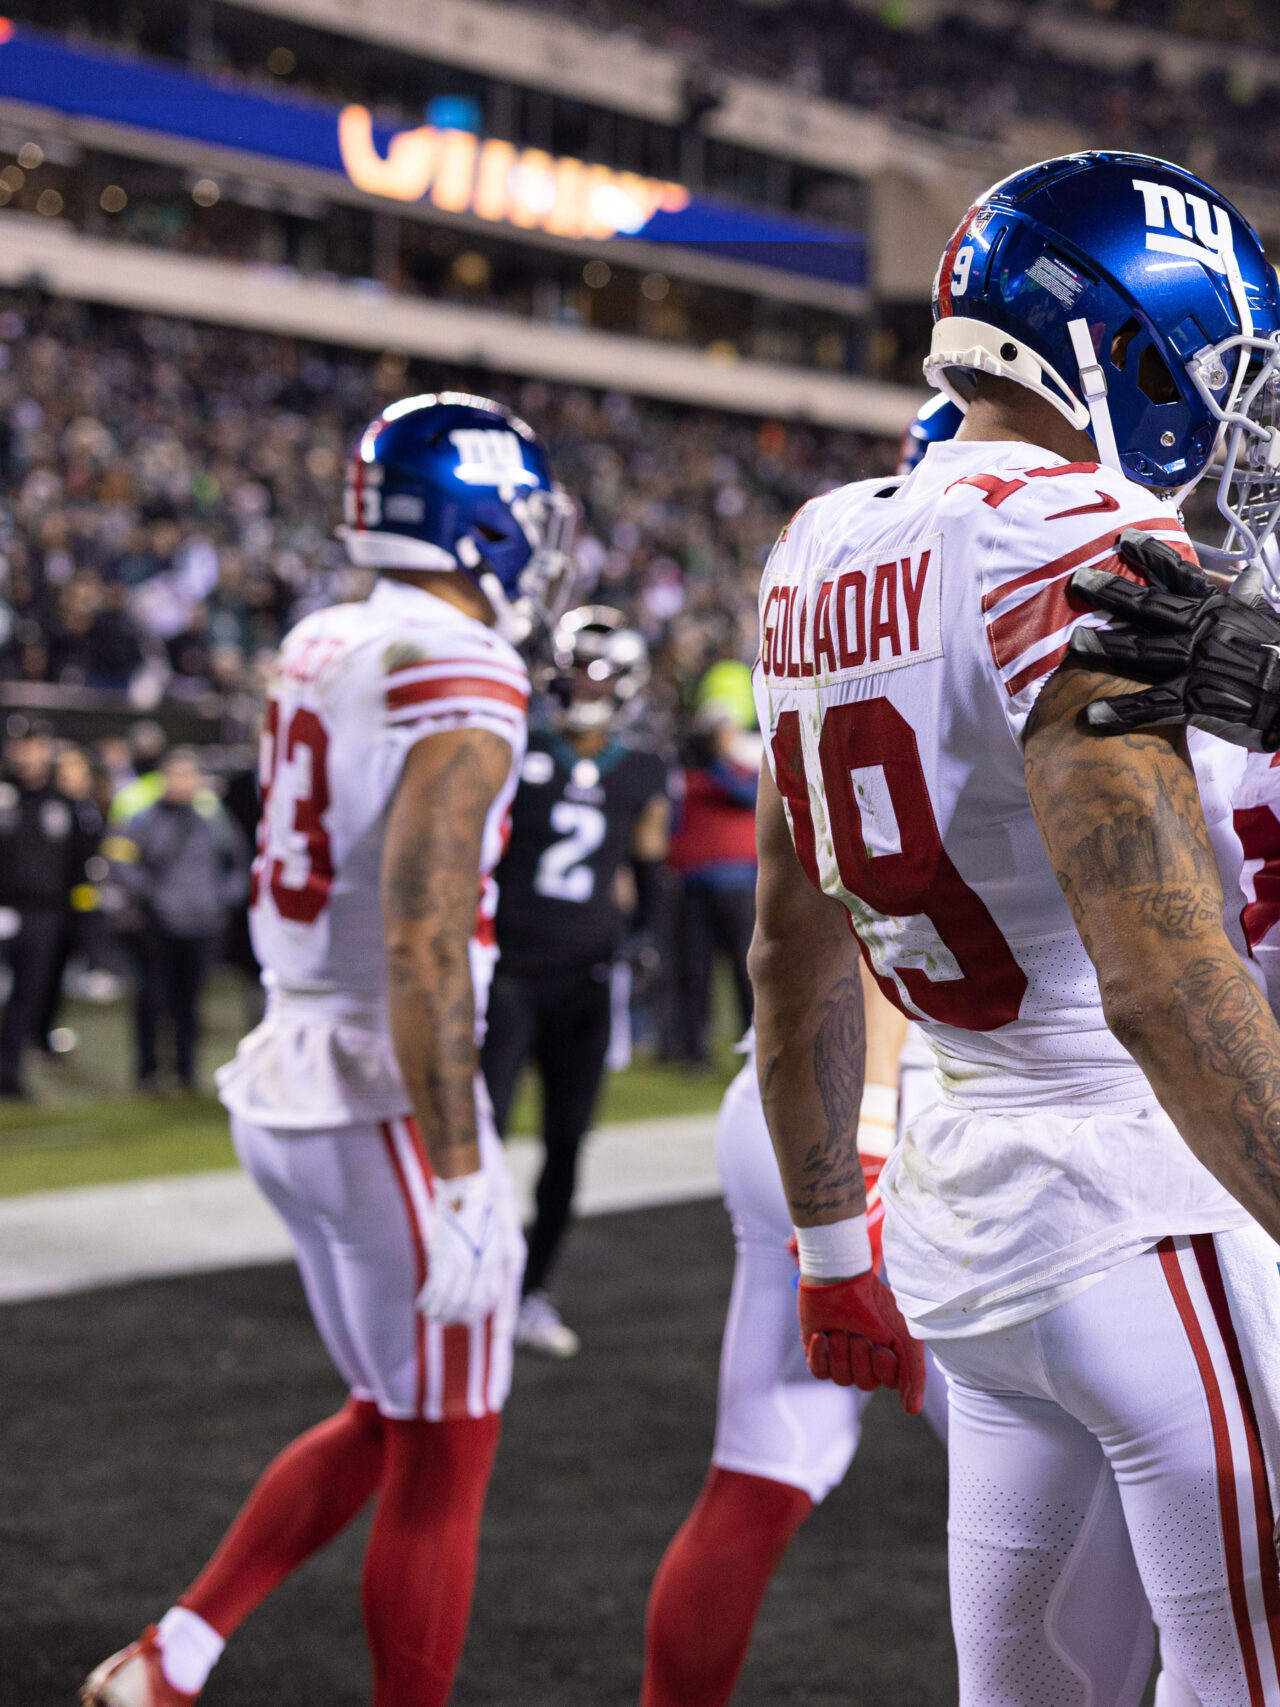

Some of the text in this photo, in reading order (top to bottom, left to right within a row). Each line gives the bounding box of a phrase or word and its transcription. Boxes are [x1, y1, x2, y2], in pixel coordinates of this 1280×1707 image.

[762, 549, 932, 678] GOLLADAY
[532, 801, 607, 904] 2
[771, 695, 1029, 1033] 19
